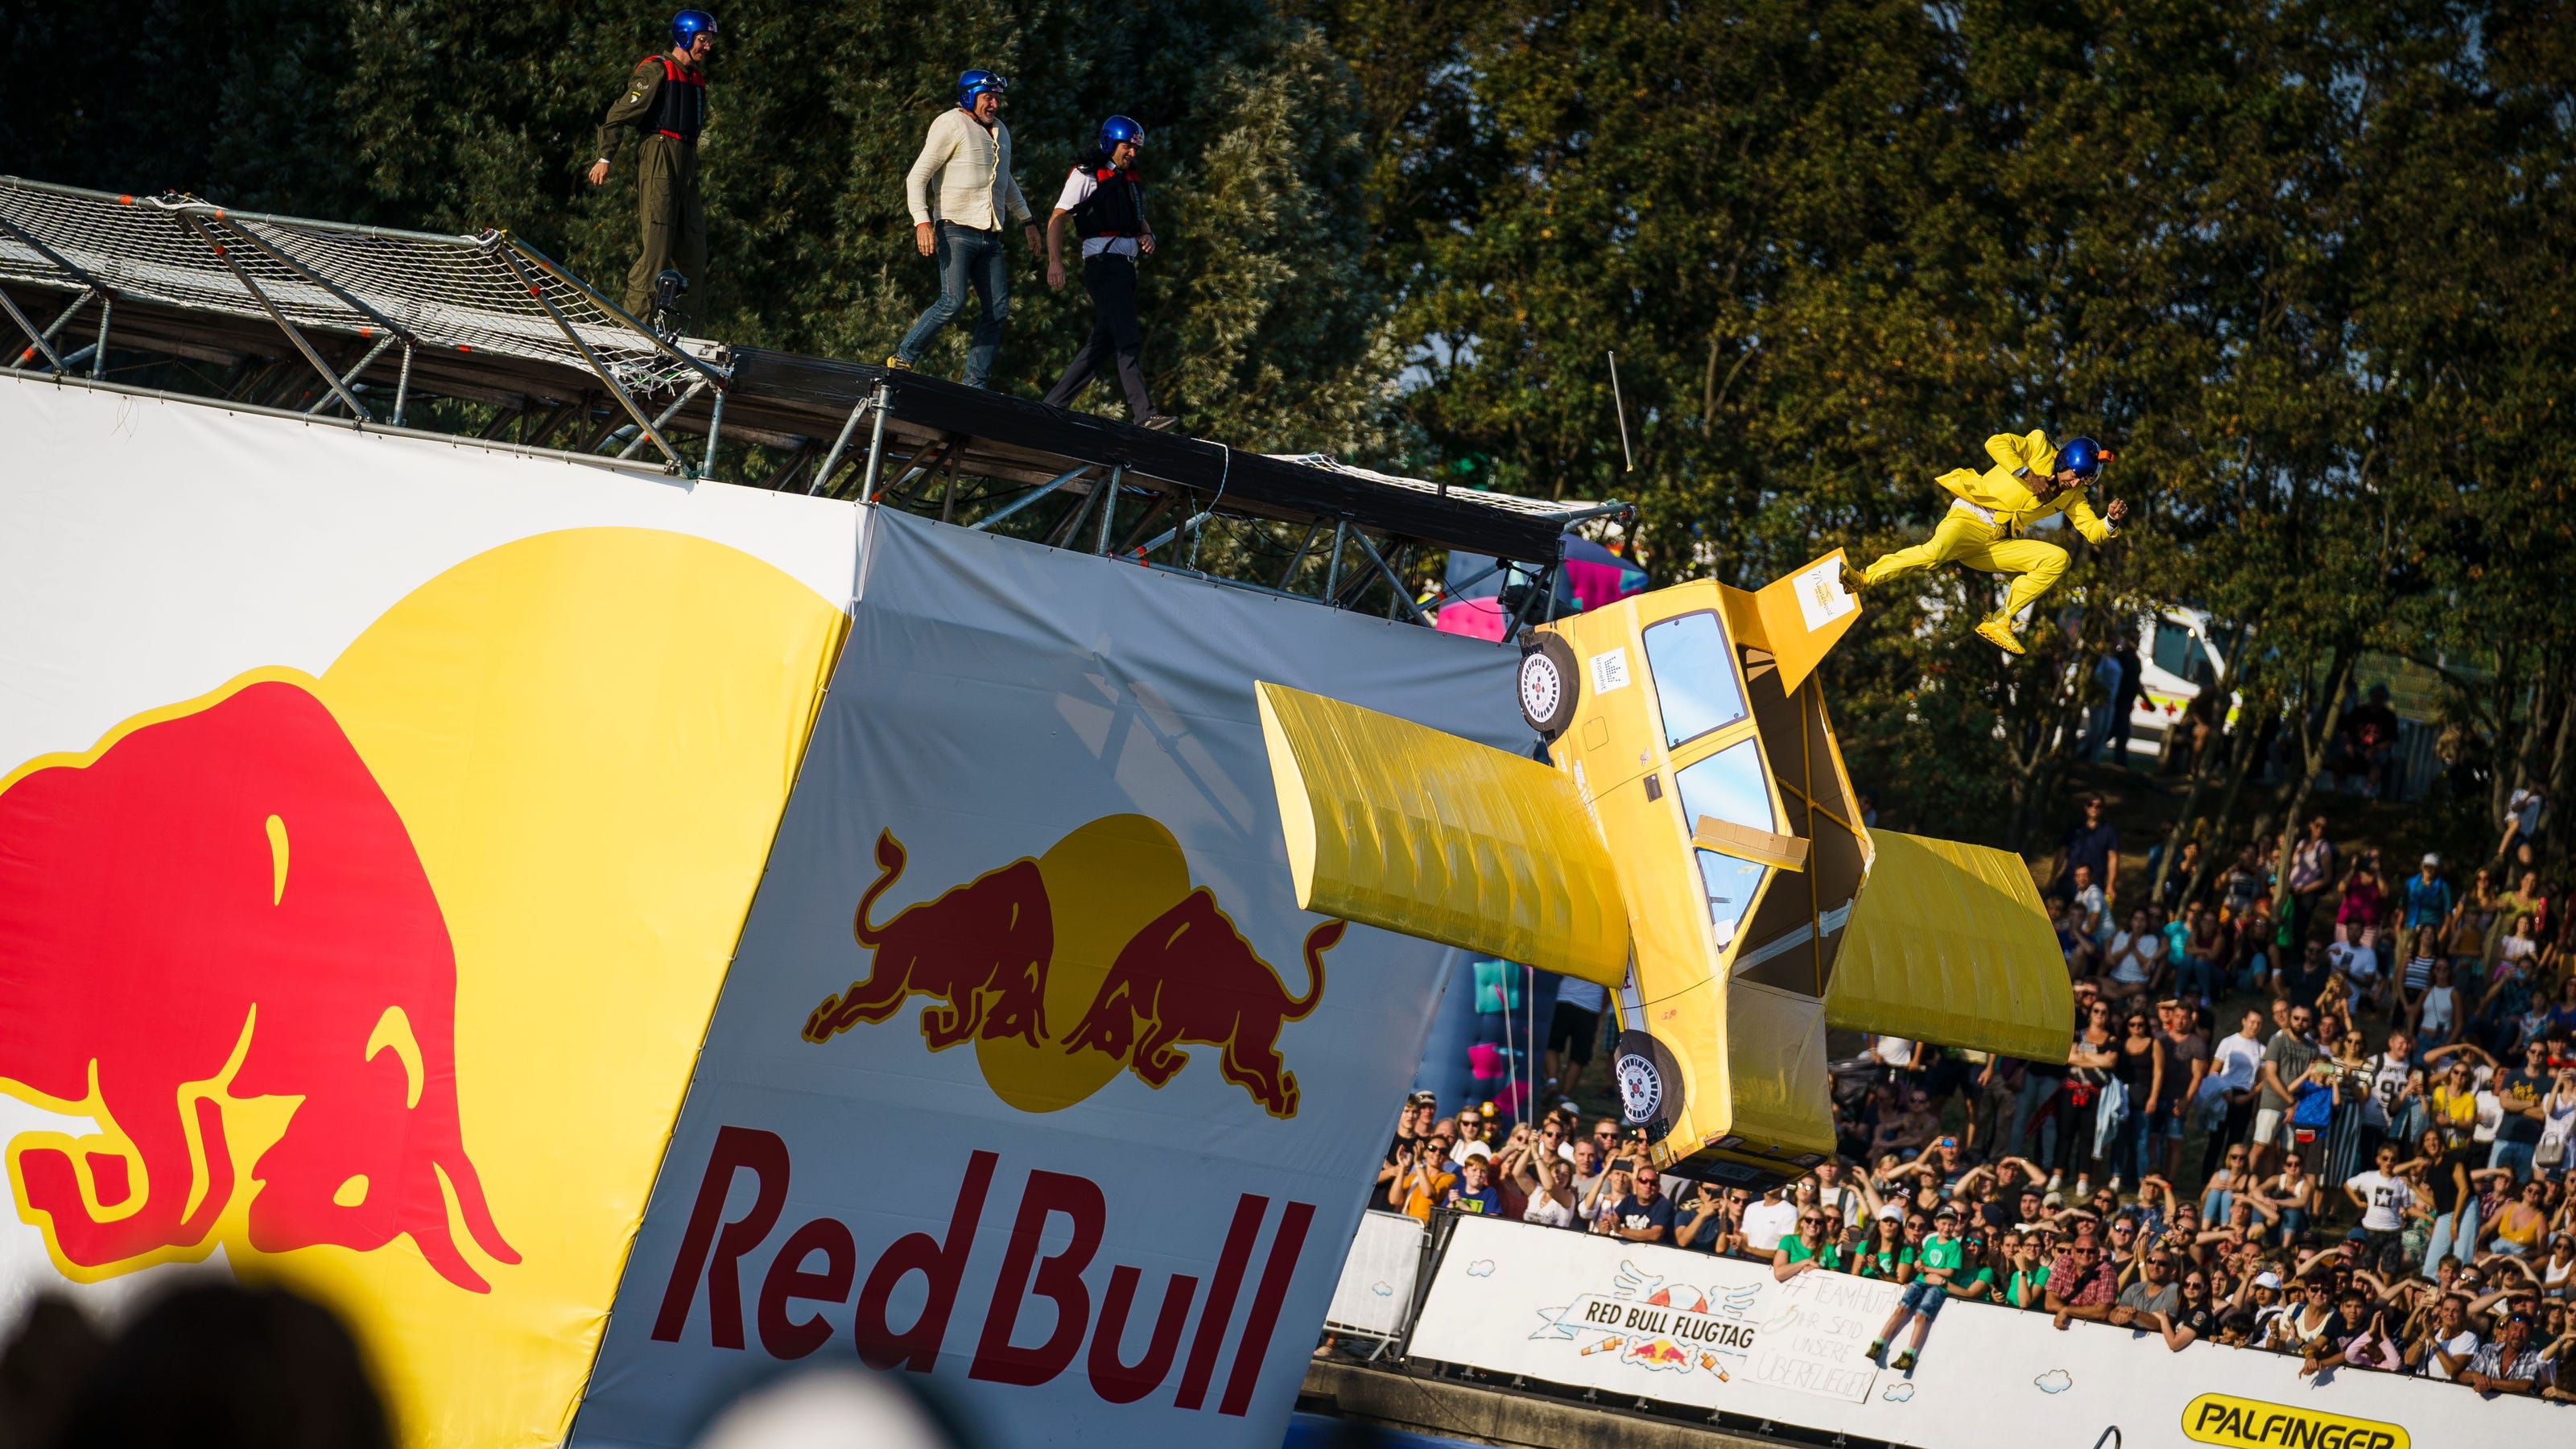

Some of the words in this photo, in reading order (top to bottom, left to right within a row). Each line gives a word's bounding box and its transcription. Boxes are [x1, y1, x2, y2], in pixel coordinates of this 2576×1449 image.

[1596, 656, 1606, 691] kronehit
[650, 1125, 1000, 1373] Red
[968, 1168, 1317, 1417] Bull
[1585, 1301, 1622, 1324] RED
[1625, 1307, 1669, 1334] BULL
[1671, 1315, 1756, 1348] FLUGTAG
[1823, 1315, 1864, 1340] SEID
[1757, 1347, 1874, 1398] ÜBERFLIEGER
[1792, 1335, 1855, 1364] UNSERE
[2195, 1402, 2396, 1449] PALFINGER
